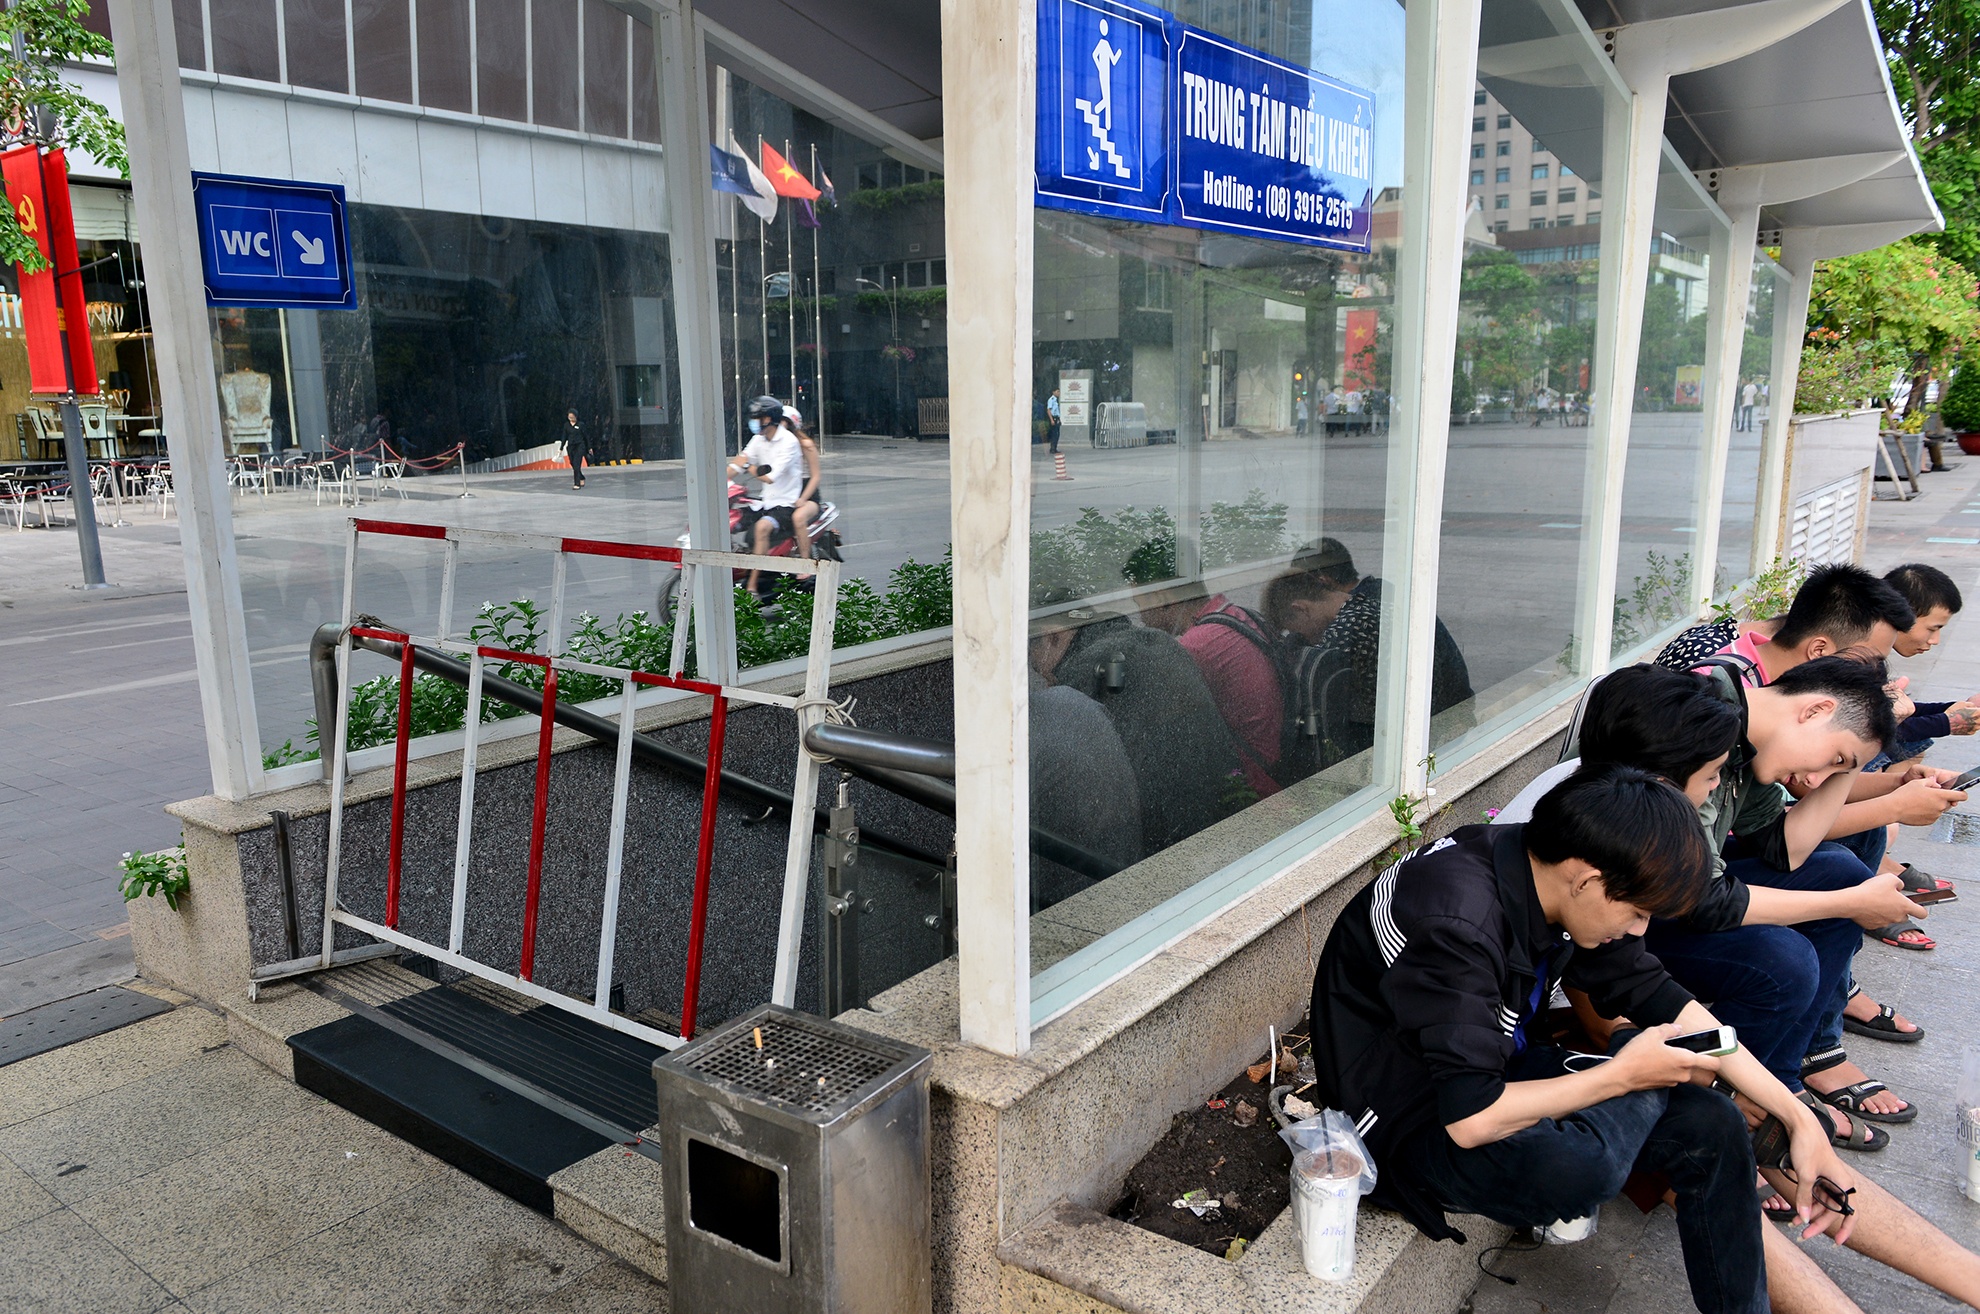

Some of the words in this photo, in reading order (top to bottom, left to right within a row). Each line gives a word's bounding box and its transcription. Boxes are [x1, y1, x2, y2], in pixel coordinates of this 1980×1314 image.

[1183, 71, 1246, 150] TRUNG
[1250, 83, 1286, 160] TÂM
[1289, 91, 1325, 170] ĐIỀU
[1328, 104, 1370, 181] KHIỂN
[1203, 169, 1254, 213] Hotline
[1265, 183, 1291, 222] (08)
[1294, 189, 1324, 225] 3915
[1326, 196, 1354, 230] 2515
[220, 229, 271, 258] WC
